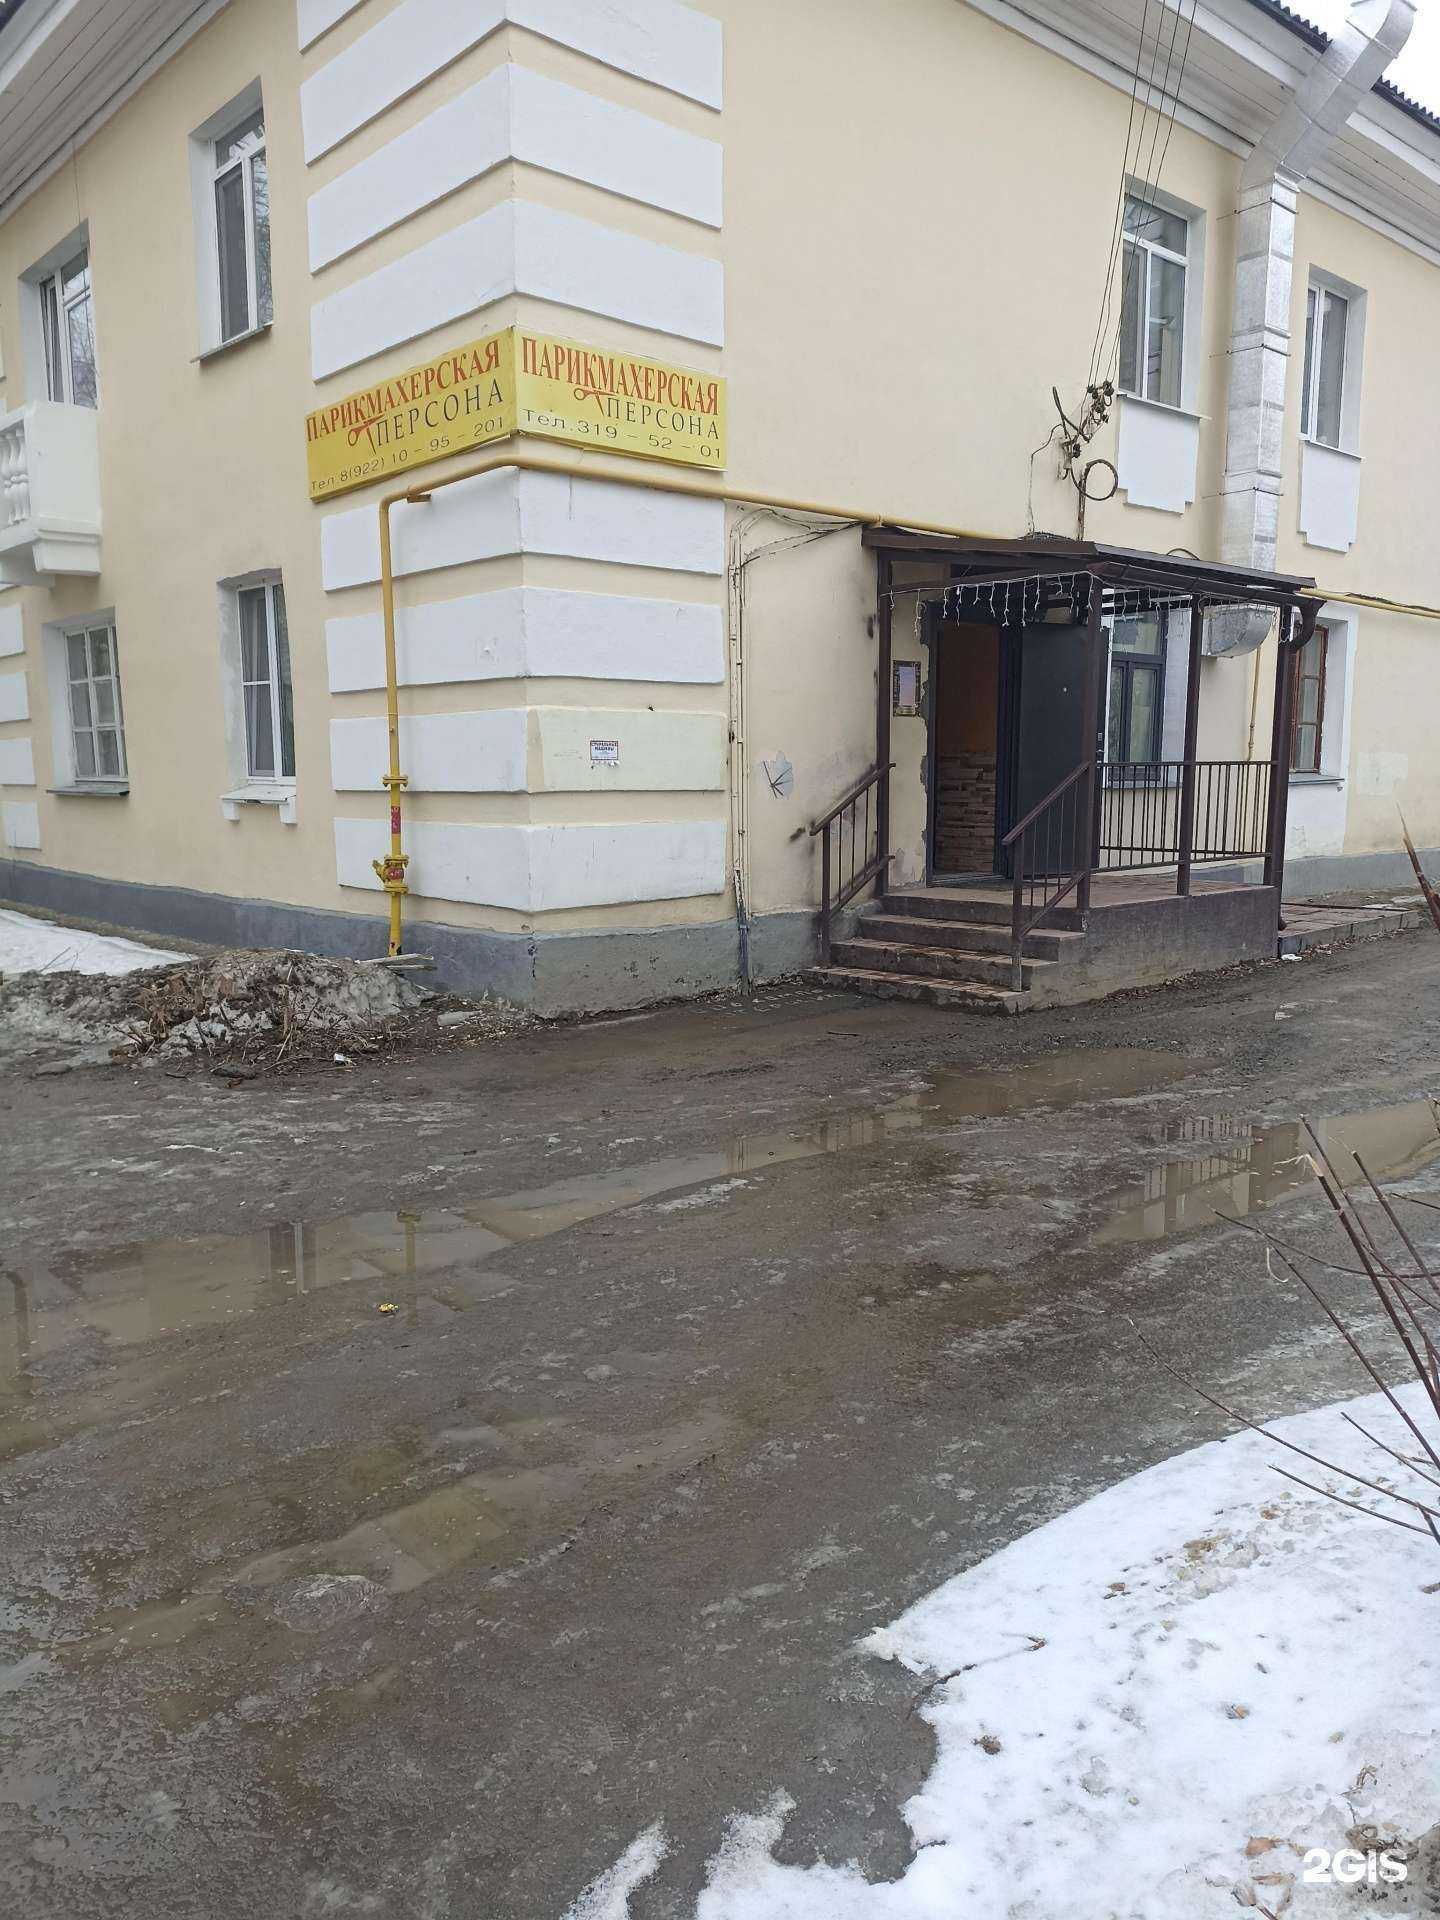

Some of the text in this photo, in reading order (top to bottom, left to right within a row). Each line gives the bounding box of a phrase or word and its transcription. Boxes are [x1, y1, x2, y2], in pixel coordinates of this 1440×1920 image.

[306, 338, 500, 442] ПАРИКМАХЕРСКАЯ
[376, 378, 504, 447] ПЕРСОНА
[522, 336, 719, 416] ПАРИКМАХЕРСКАЯ
[606, 397, 720, 440] ПЕРСОНА
